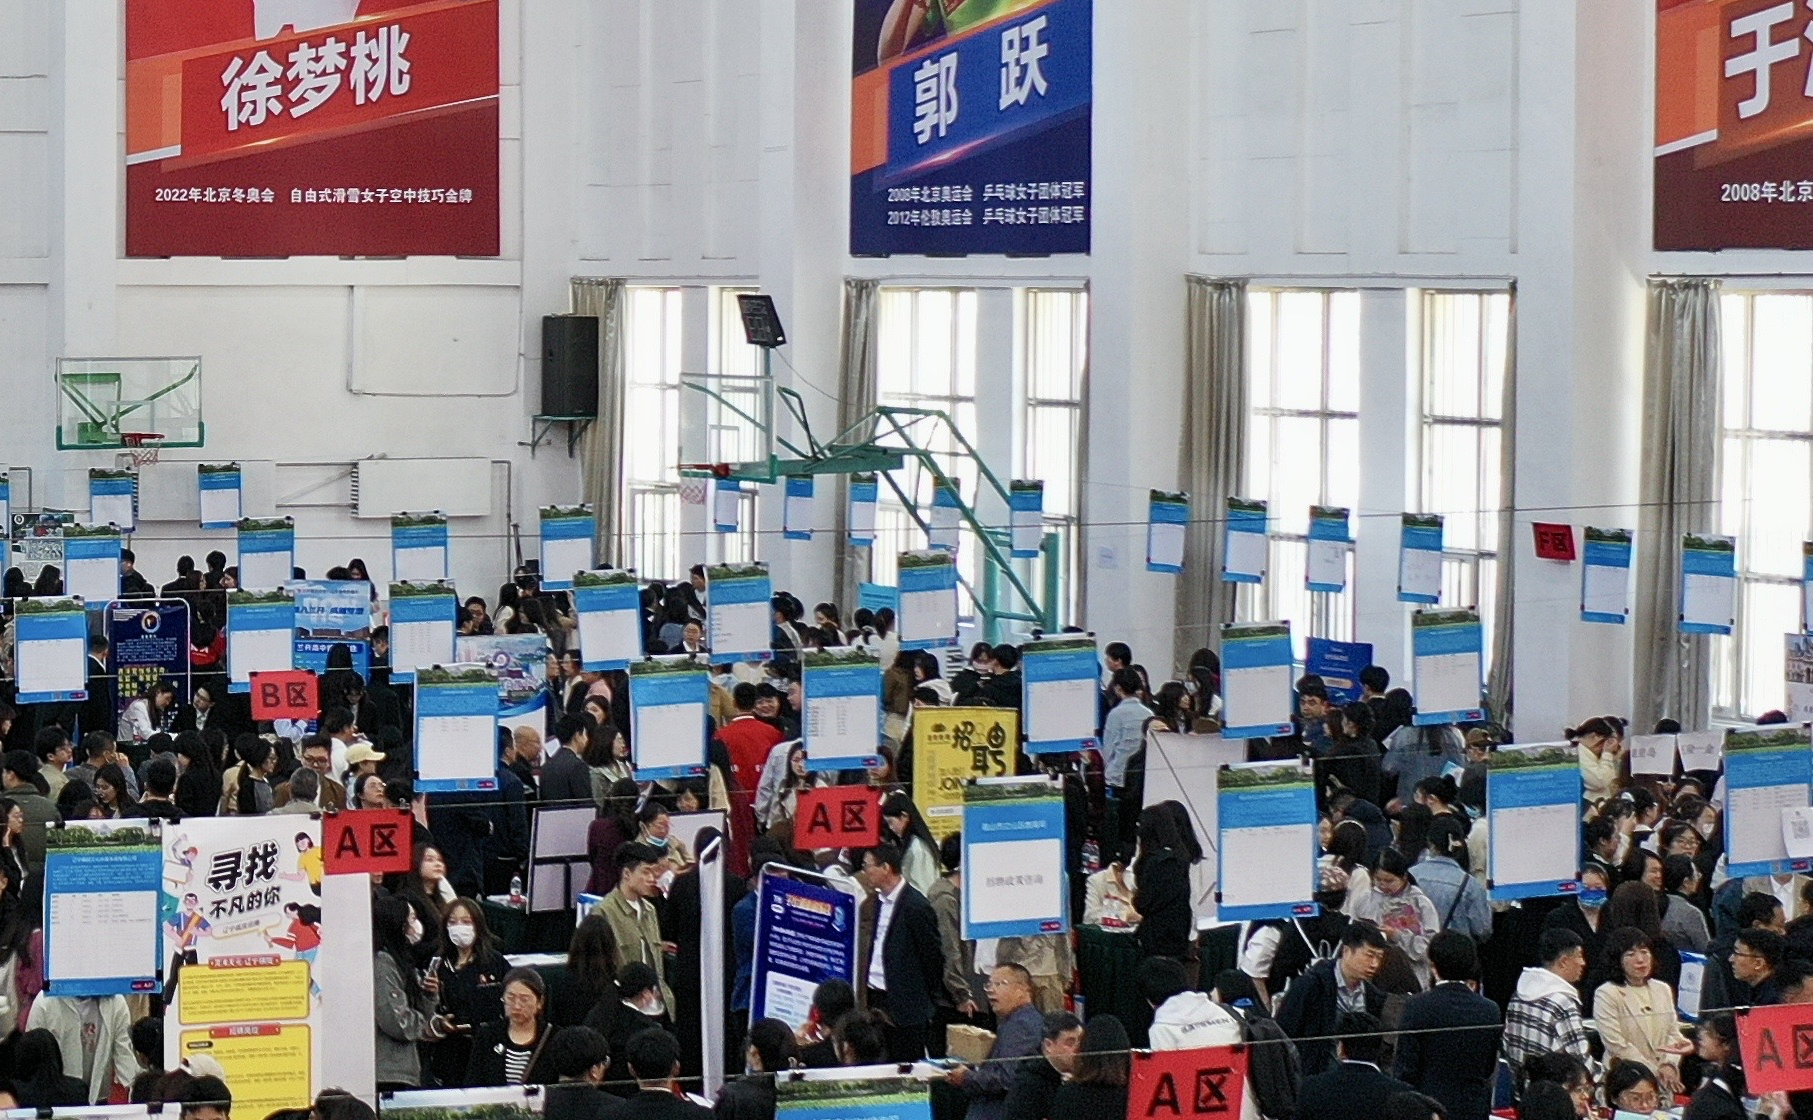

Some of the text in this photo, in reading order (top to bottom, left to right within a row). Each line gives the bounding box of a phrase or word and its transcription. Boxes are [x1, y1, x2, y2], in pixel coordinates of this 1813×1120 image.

[220, 23, 411, 131] 徐梦桃
[1724, 1, 1813, 119] 于
[155, 187, 473, 204] 2022年北京冬奥会 自由式滑雪女子空中技巧金牌
[887, 181, 1085, 203] 2008年北京奥运会 乒乓球女子团体冠军
[887, 206, 1085, 226] 2012年伦敦奥运会 乒乓球女子团体冠军
[260, 683, 309, 708] B区
[807, 801, 867, 835] A区
[334, 822, 400, 860] A区
[207, 841, 280, 892] 寻找
[209, 886, 281, 919] 不凡的你
[1147, 1067, 1231, 1117] A区
